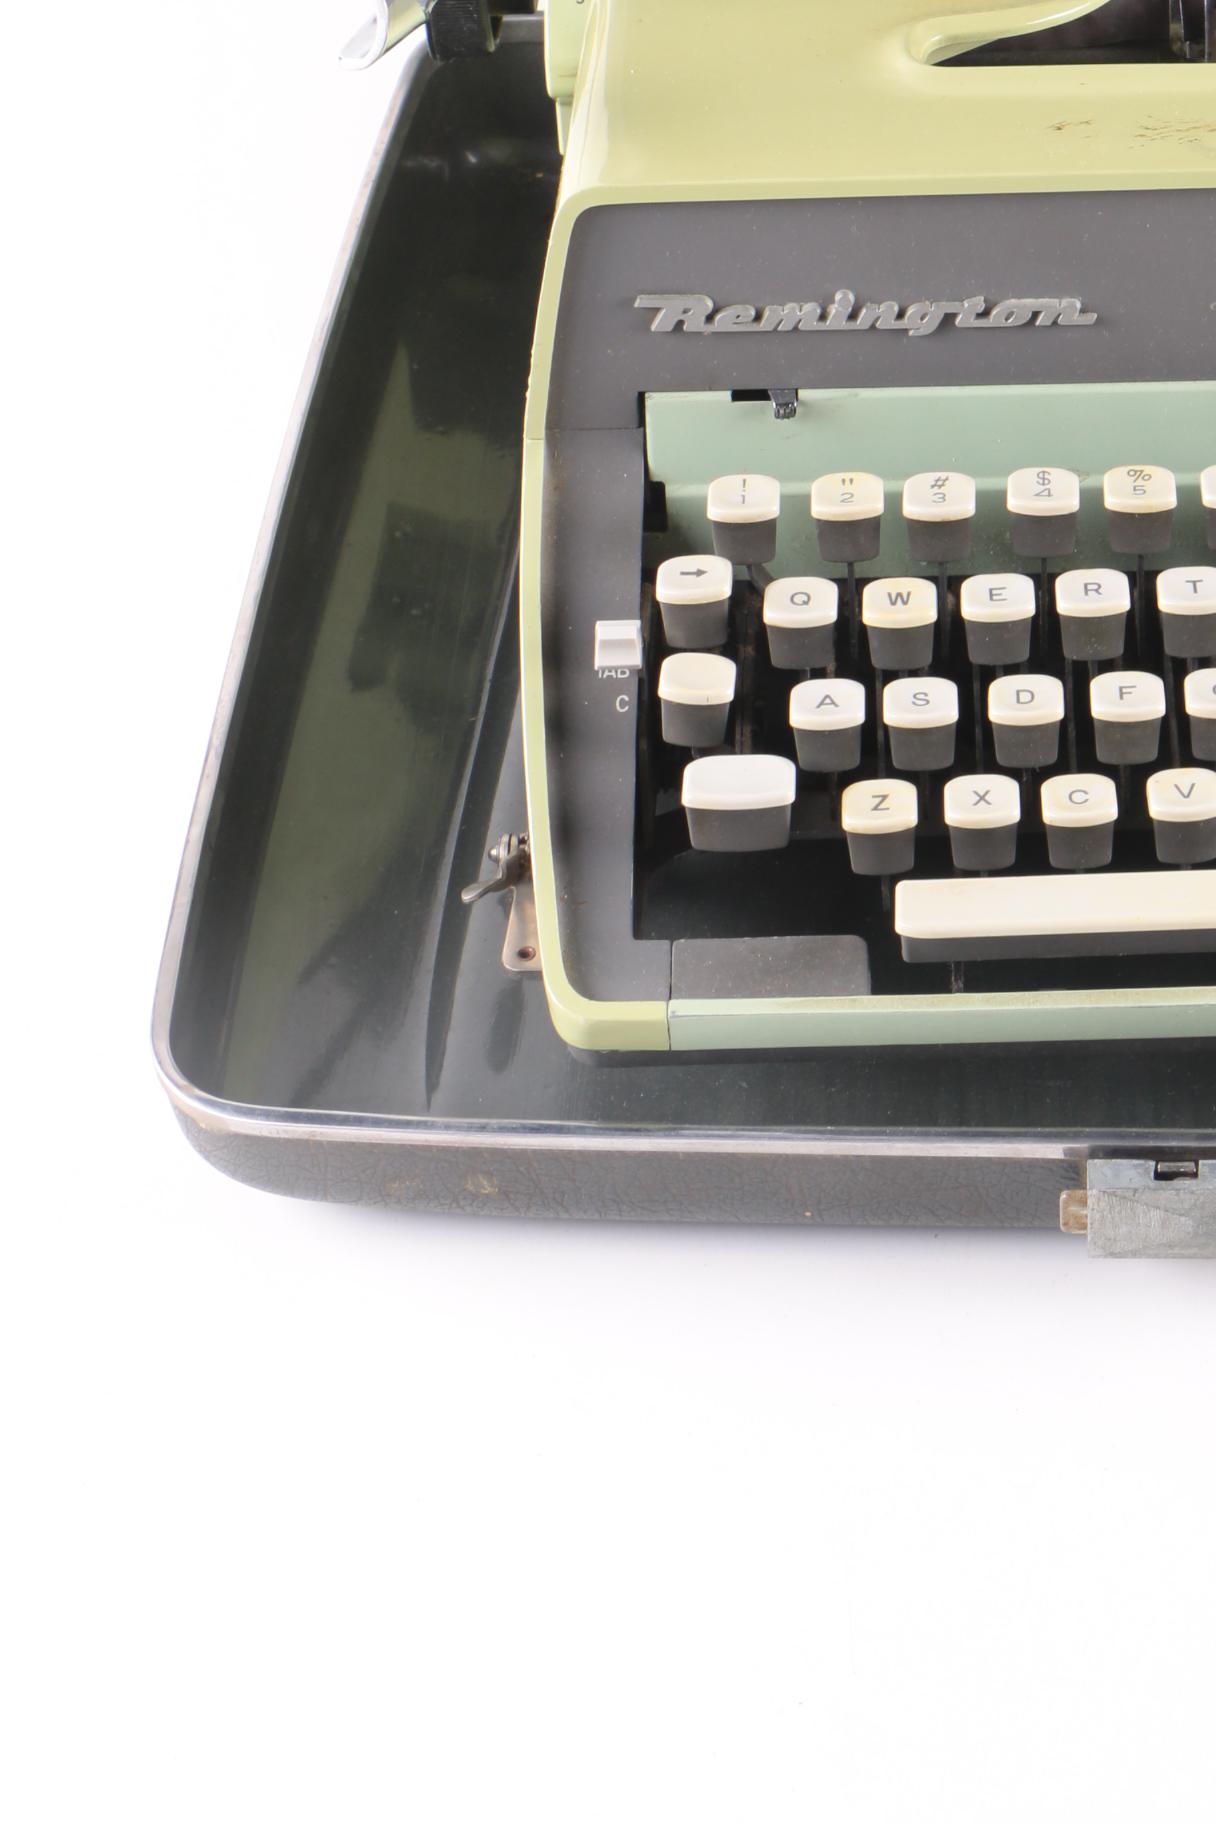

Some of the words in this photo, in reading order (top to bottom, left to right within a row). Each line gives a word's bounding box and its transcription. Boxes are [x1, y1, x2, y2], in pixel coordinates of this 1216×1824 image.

[633, 289, 1097, 337] Remington
[931, 477, 948, 489] #
[1037, 471, 1051, 489] $
[1127, 469, 1152, 486] %
[1034, 488, 1053, 497] 4
[1132, 484, 1147, 496] 5
[740, 494, 747, 505] 1
[840, 492, 854, 503] 2
[933, 492, 946, 503] 3
[1084, 583, 1101, 596] R
[1186, 580, 1203, 593] T
[790, 592, 811, 606] Q
[886, 591, 912, 607] W
[989, 587, 1006, 601] E
[912, 692, 930, 706] S
[1016, 690, 1034, 704] D
[1119, 686, 1136, 700] F
[616, 695, 629, 712] C
[816, 695, 838, 708] A
[1069, 789, 1088, 804] C
[1174, 783, 1195, 798] V
[872, 794, 889, 811] Z
[973, 790, 991, 806] X
